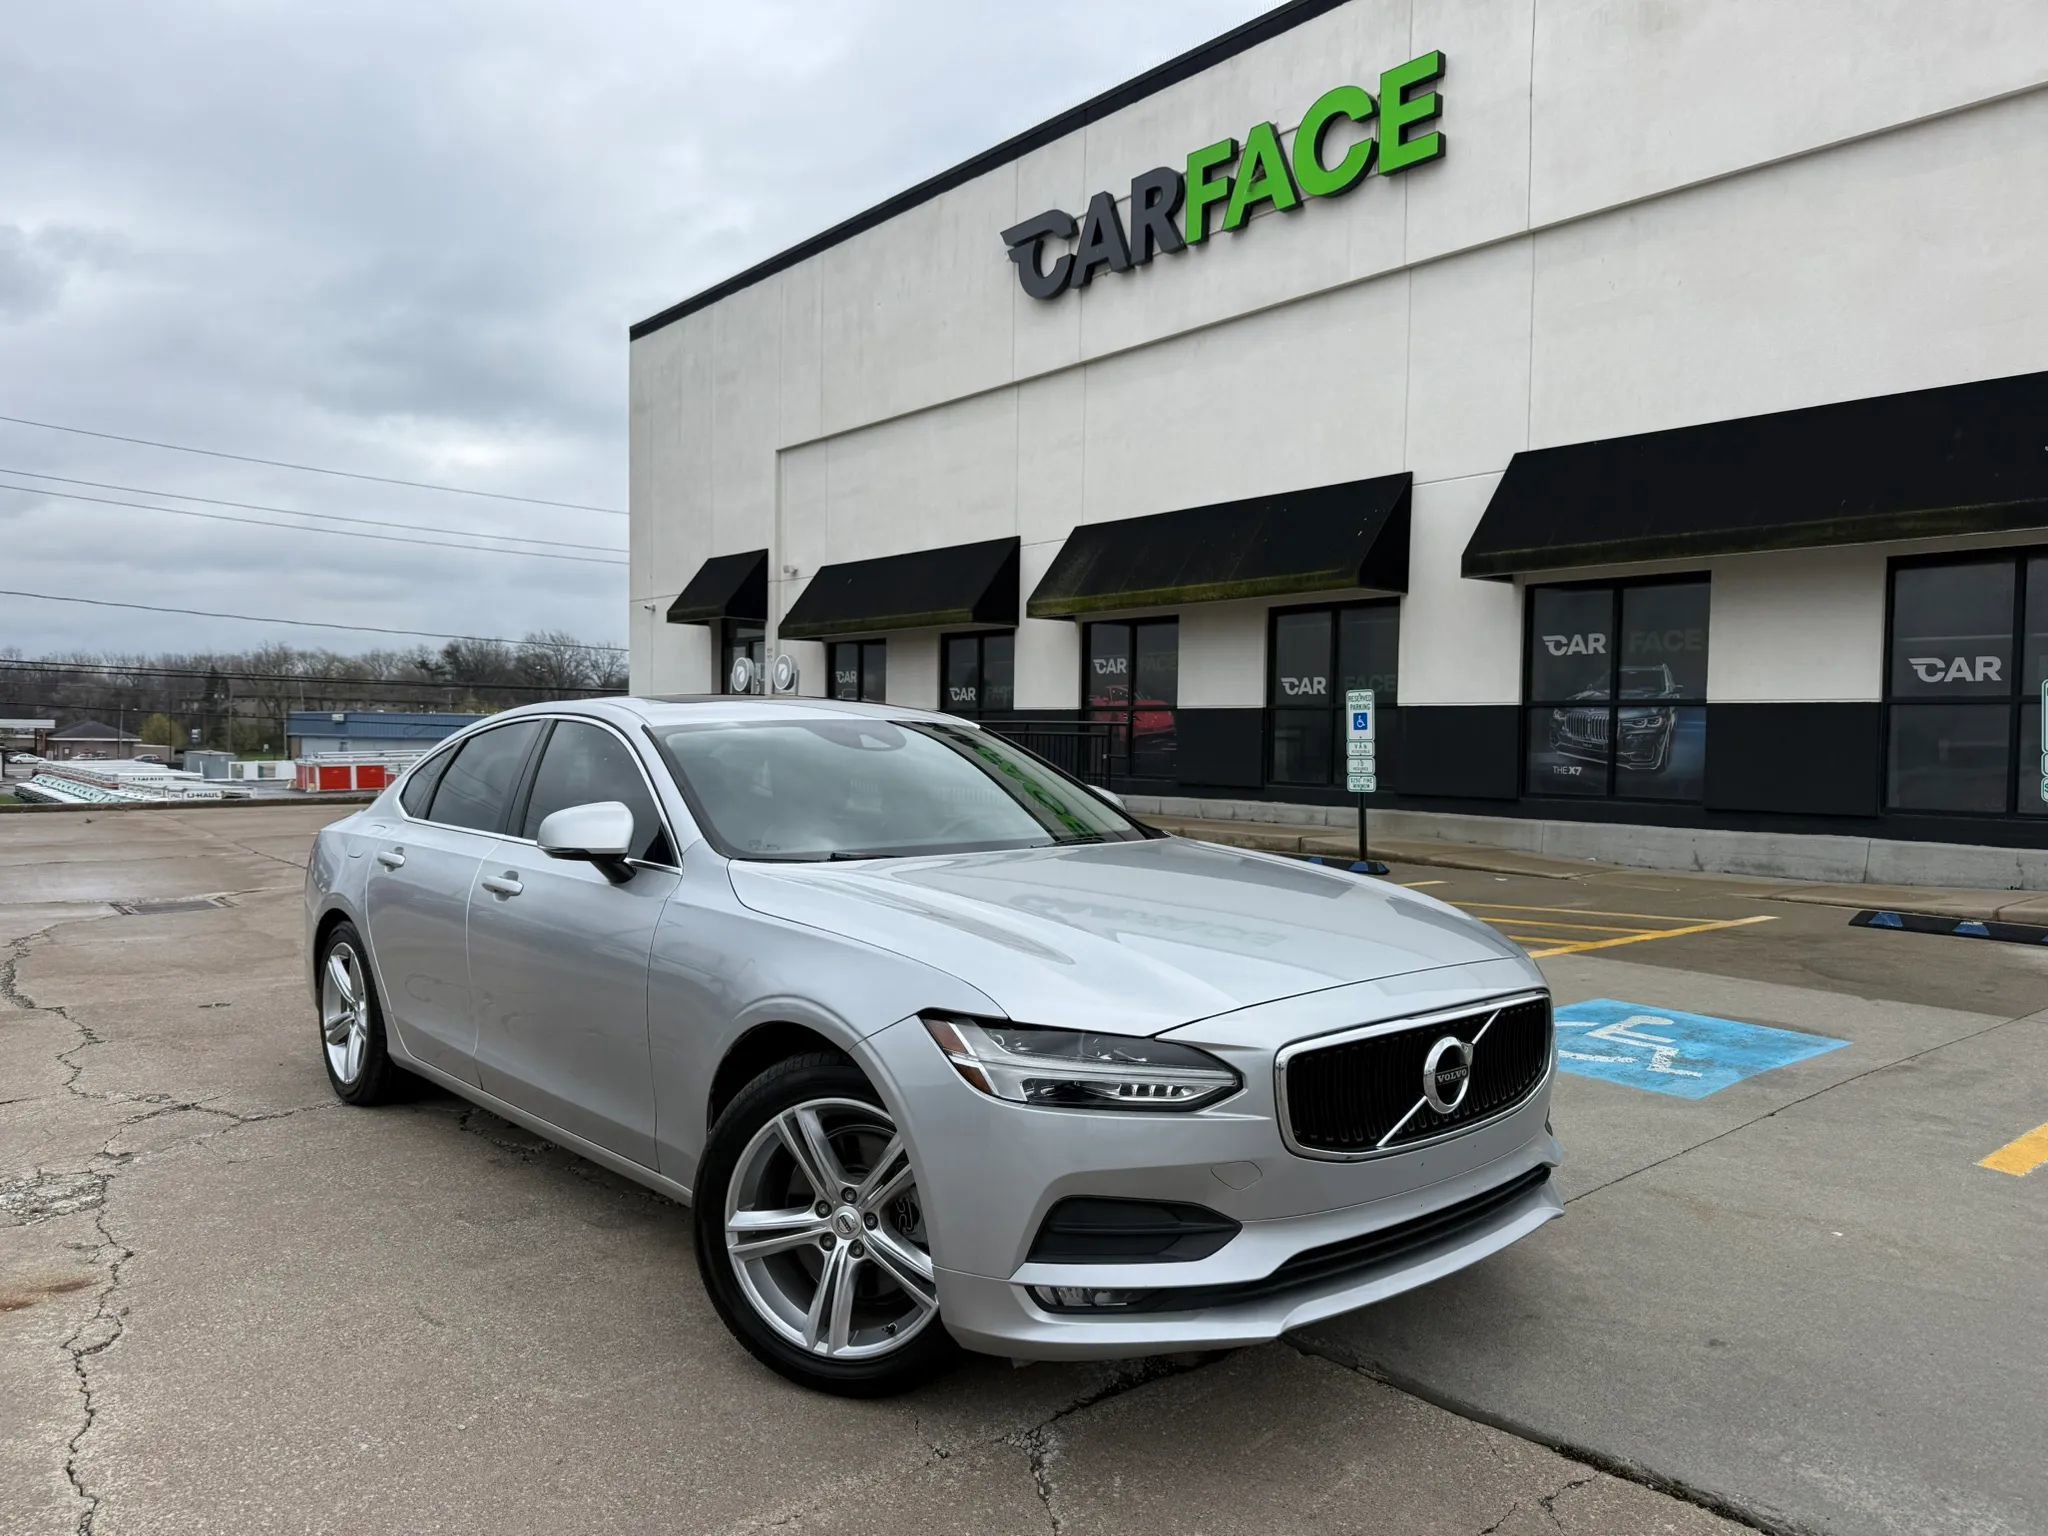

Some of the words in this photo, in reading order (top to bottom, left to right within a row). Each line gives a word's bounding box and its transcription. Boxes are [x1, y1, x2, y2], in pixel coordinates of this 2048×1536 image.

[1000, 49, 1446, 300] CARFACE
[1542, 633, 1607, 656] CAR
[1093, 657, 1127, 675] CAR
[1908, 655, 2002, 683] CAR
[836, 671, 857, 683] CAR
[949, 687, 976, 701] CAR
[1281, 676, 1327, 696] CAR
[1349, 703, 1371, 711] PARKING
[1552, 765, 1568, 775] THE
[1568, 766, 1583, 776] X7
[1437, 1068, 1468, 1083] VOLVO
